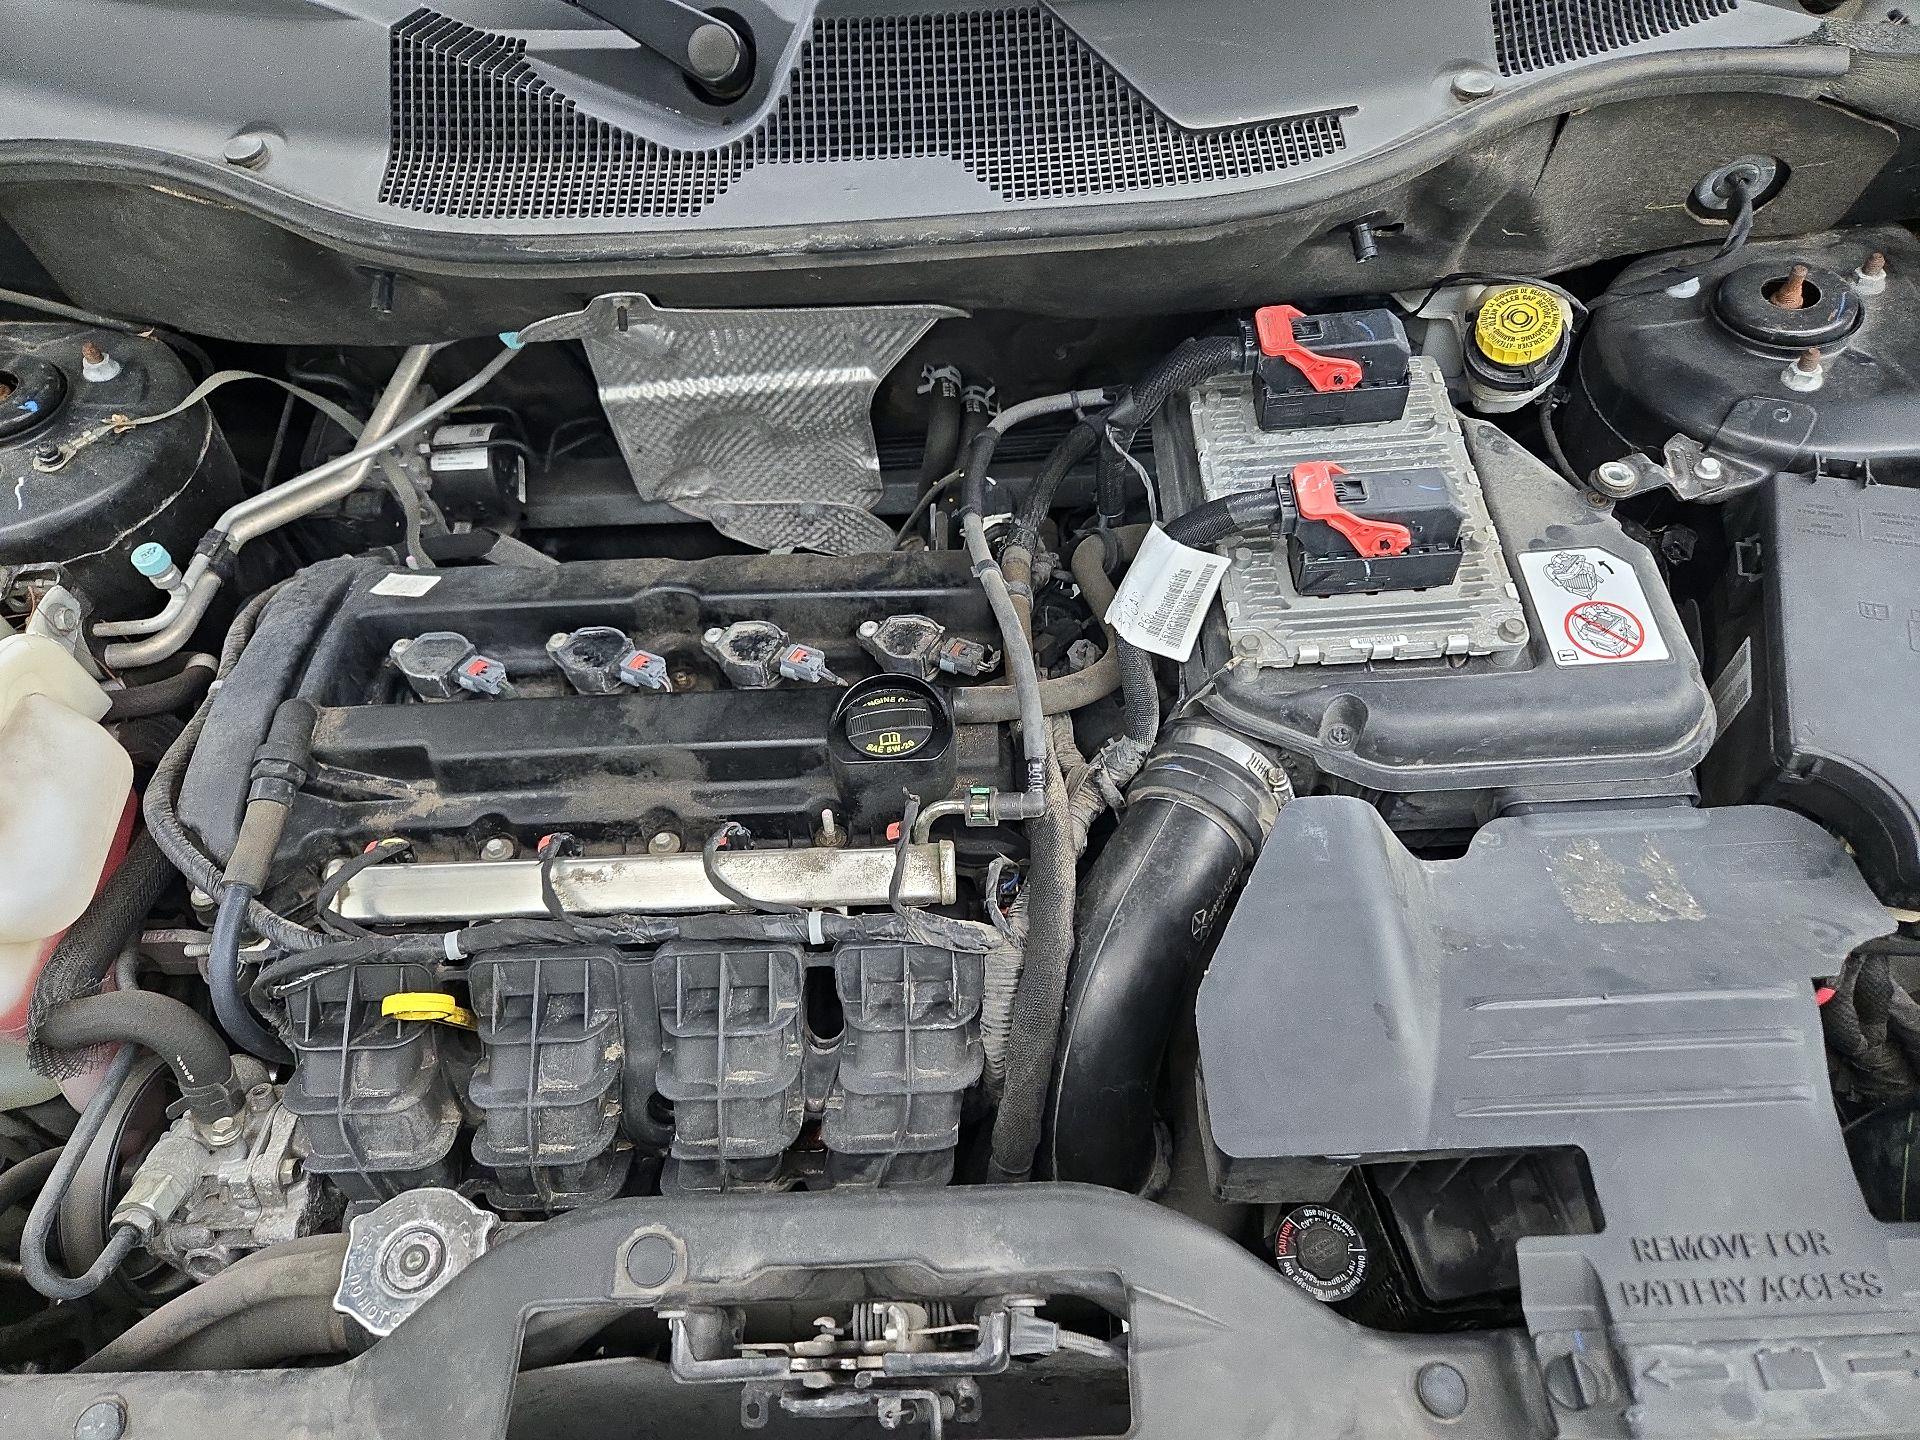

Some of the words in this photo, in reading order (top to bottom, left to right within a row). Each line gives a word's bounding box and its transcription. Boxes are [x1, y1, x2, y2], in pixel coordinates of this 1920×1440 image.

[1536, 299, 1552, 319] BEFORE
[865, 743, 885, 754] SAE
[886, 739, 916, 754] 5W-20
[1303, 1208, 1317, 1217] Use
[1317, 1209, 1331, 1220] only
[1332, 1213, 1357, 1237] Chrysler
[1279, 1222, 1294, 1255] CAUTION
[1630, 1232, 1755, 1264] REMOVE
[1765, 1229, 1833, 1258] FOR
[1283, 1261, 1294, 1276] the
[1357, 1255, 1366, 1277] Other
[1292, 1274, 1323, 1297] damage
[1325, 1288, 1340, 1299] will
[1341, 1275, 1361, 1294] fluids
[1618, 1276, 1748, 1308] BATTERY
[1760, 1269, 1885, 1303] ACCESS
